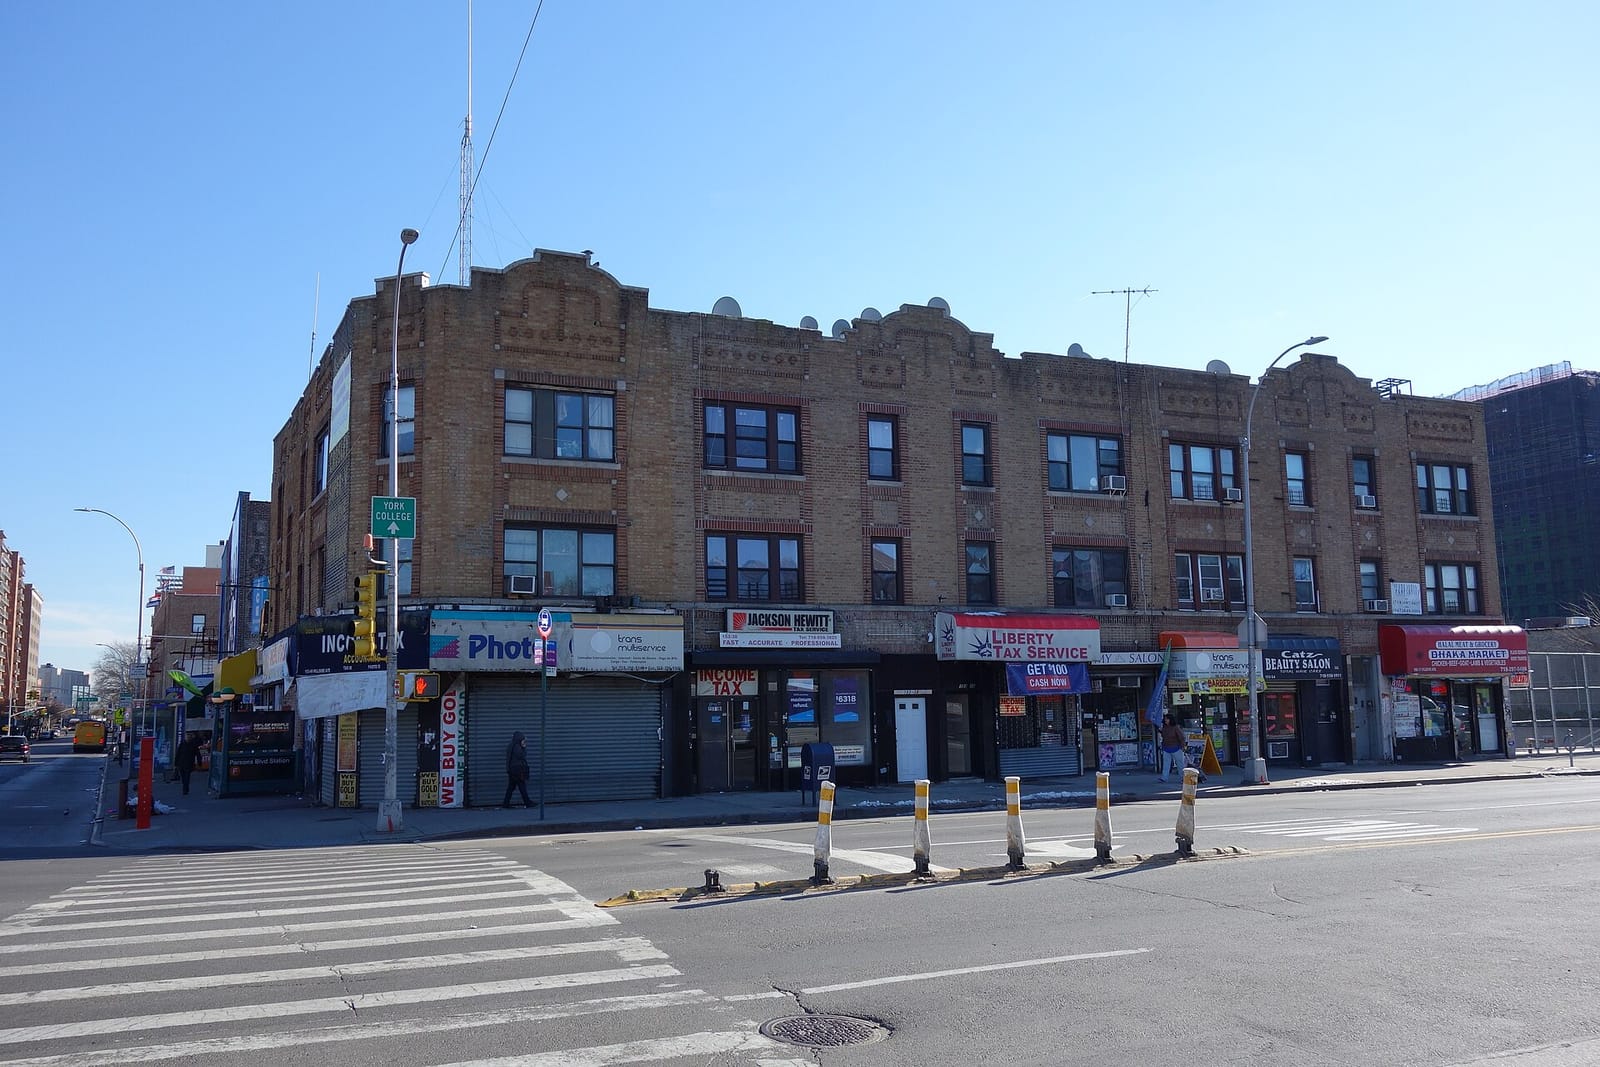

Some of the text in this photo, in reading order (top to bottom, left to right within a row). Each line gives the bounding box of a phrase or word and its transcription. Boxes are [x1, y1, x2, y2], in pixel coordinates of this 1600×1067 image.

[384, 502, 404, 510] YORK
[376, 512, 411, 520] COLLEGE
[748, 613, 830, 628] JACKSON HEWITT
[618, 634, 642, 643] trans
[992, 630, 1054, 645] LIBERTY
[618, 644, 666, 652] multiservice
[992, 646, 1088, 659] TAX SERVICE
[1212, 653, 1234, 662] trans
[1281, 650, 1323, 658] Catz
[1468, 650, 1508, 658] MARKET
[1265, 658, 1330, 670] BEAUTY SALON
[1028, 664, 1068, 675] GET $100
[700, 669, 756, 681] INCOME
[1029, 678, 1067, 687] CASH NOW
[1208, 679, 1246, 687] BARBERSHOP
[712, 681, 742, 696] TAX
[1005, 704, 1020, 713] TAX
[443, 731, 456, 769] BUY
[340, 786, 355, 794] GOLD
[442, 776, 454, 806] WE
